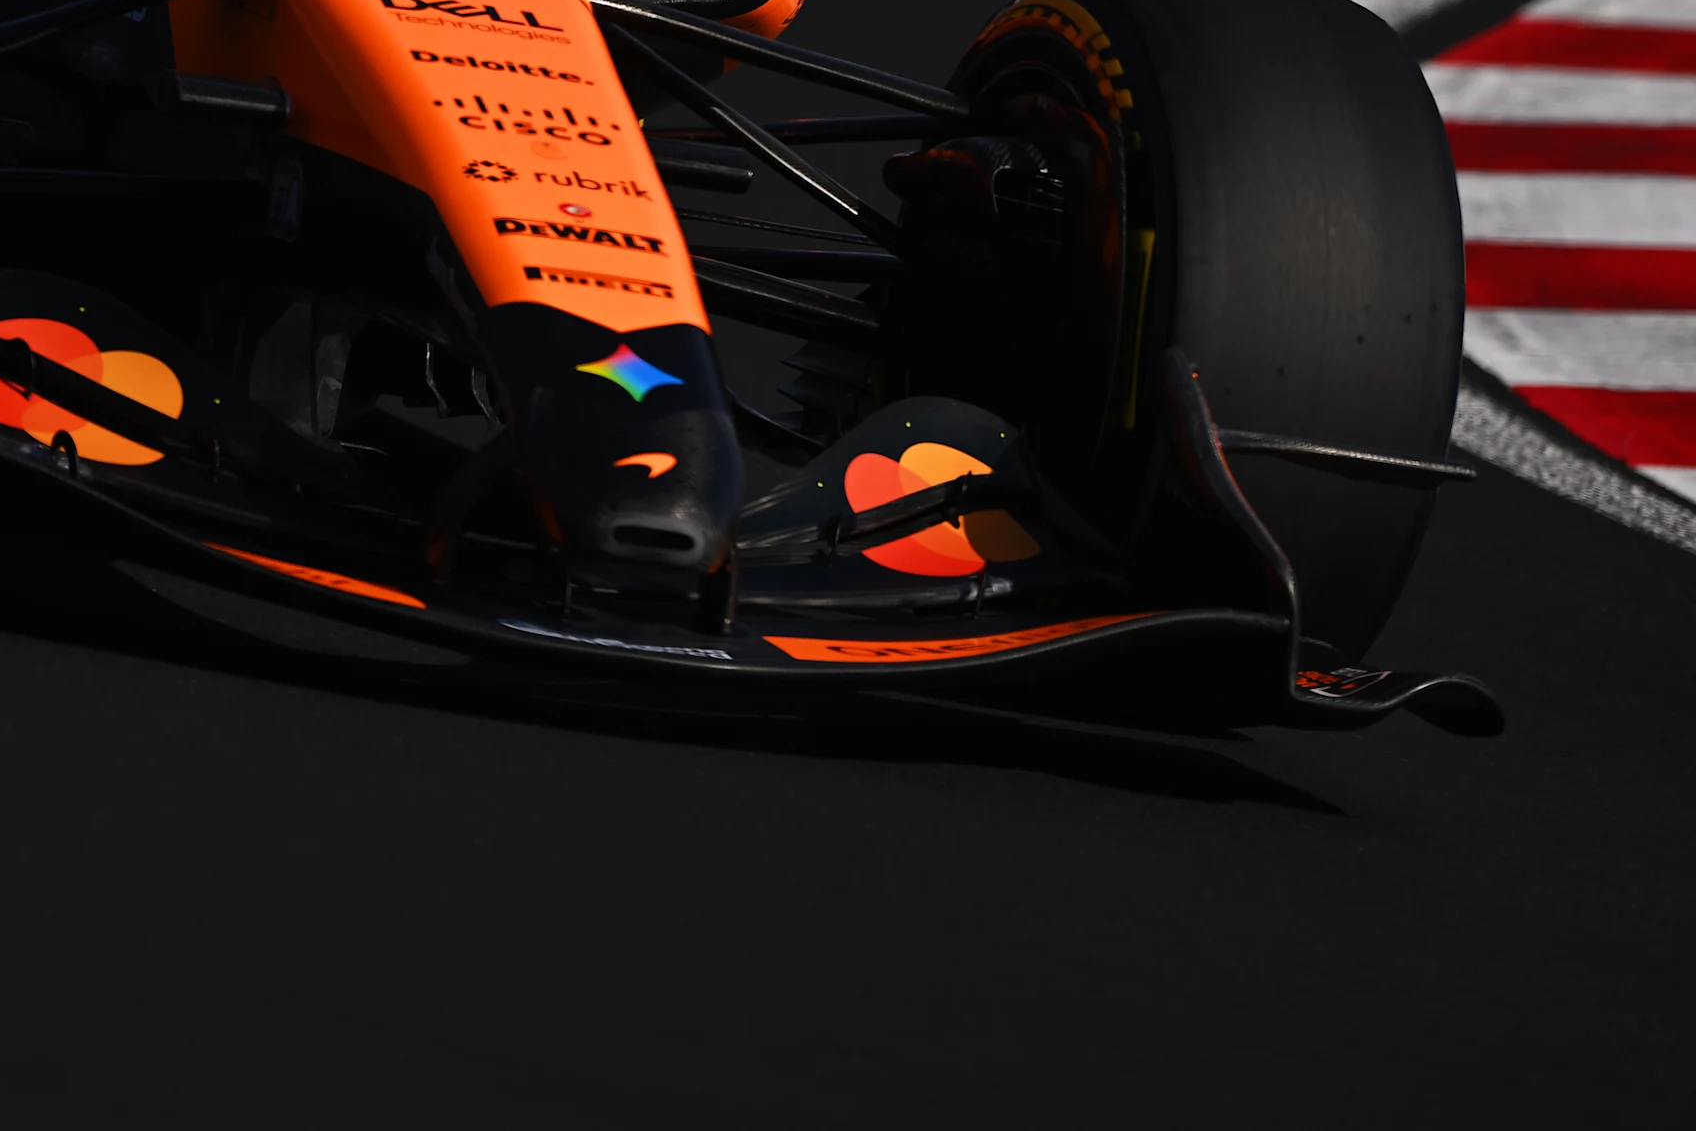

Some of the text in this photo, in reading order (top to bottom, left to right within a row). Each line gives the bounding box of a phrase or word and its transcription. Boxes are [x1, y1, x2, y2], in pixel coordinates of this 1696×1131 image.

[392, 12, 572, 45] Technologies
[409, 49, 595, 87] Deloitte.
[534, 171, 655, 204] rubrik
